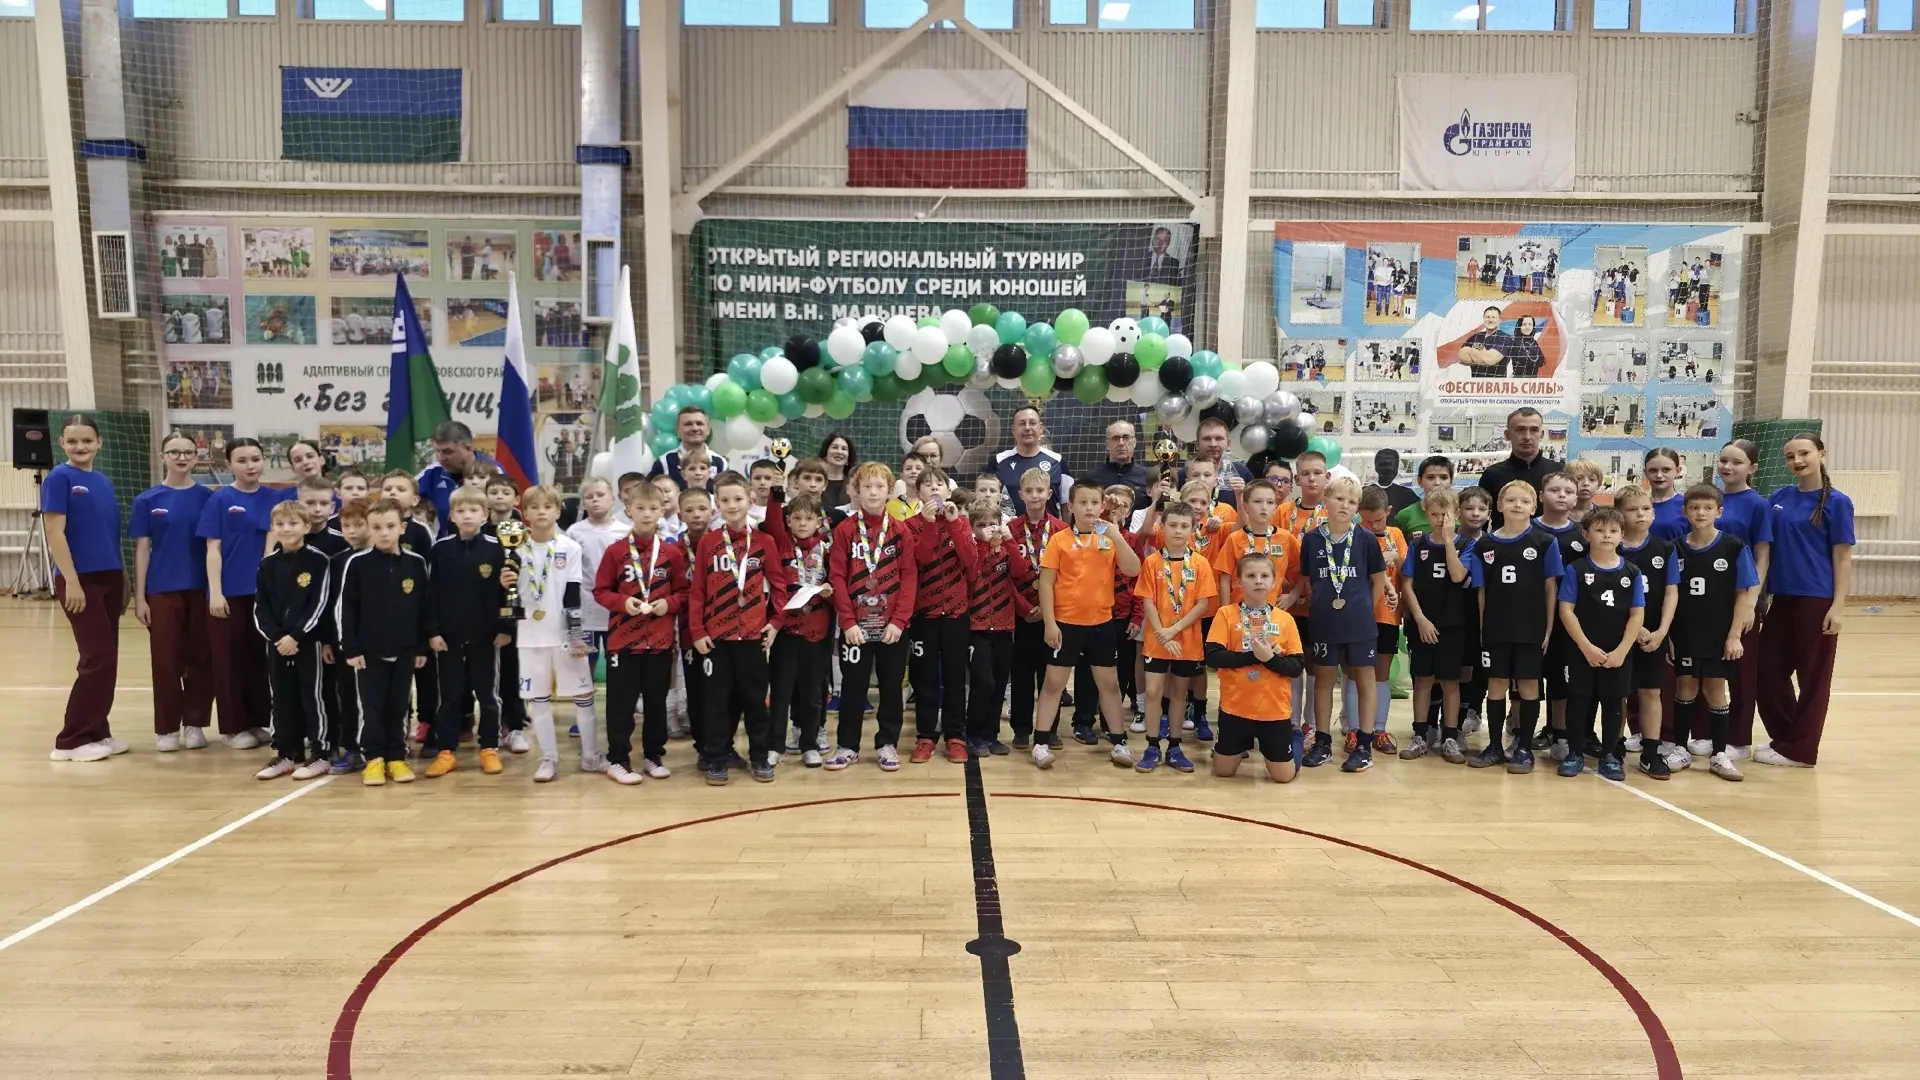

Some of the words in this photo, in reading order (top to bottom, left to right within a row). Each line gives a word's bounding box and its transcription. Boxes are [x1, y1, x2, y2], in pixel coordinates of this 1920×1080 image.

[1473, 122, 1532, 138] ГАЗПРОМ
[1473, 139, 1532, 148] ТРАНСГАЗ
[827, 247, 996, 269] РЕГИОНАЛЬНЫЙ
[1003, 251, 1085, 270] ТУРНИР
[739, 274, 908, 295] МИНИ-ФУТБОЛУ
[914, 277, 982, 298] СРЕДИ
[989, 275, 1087, 297] ЮНОШЕЙ
[784, 303, 824, 321] В.Н.
[302, 364, 374, 378] АДАПТИВНЫЙ
[1438, 380, 1519, 395] «ФЕСТИВАЛЬ
[1521, 382, 1564, 396] СИЛЫ»
[713, 554, 732, 572] 10
[1432, 562, 1446, 579] 5
[623, 564, 635, 583] 3
[1501, 564, 1517, 584] 6
[1689, 576, 1706, 596] 9
[1600, 589, 1615, 607] 4
[610, 653, 619, 668] 3
[841, 644, 861, 664] 30
[1481, 650, 1491, 668] 6
